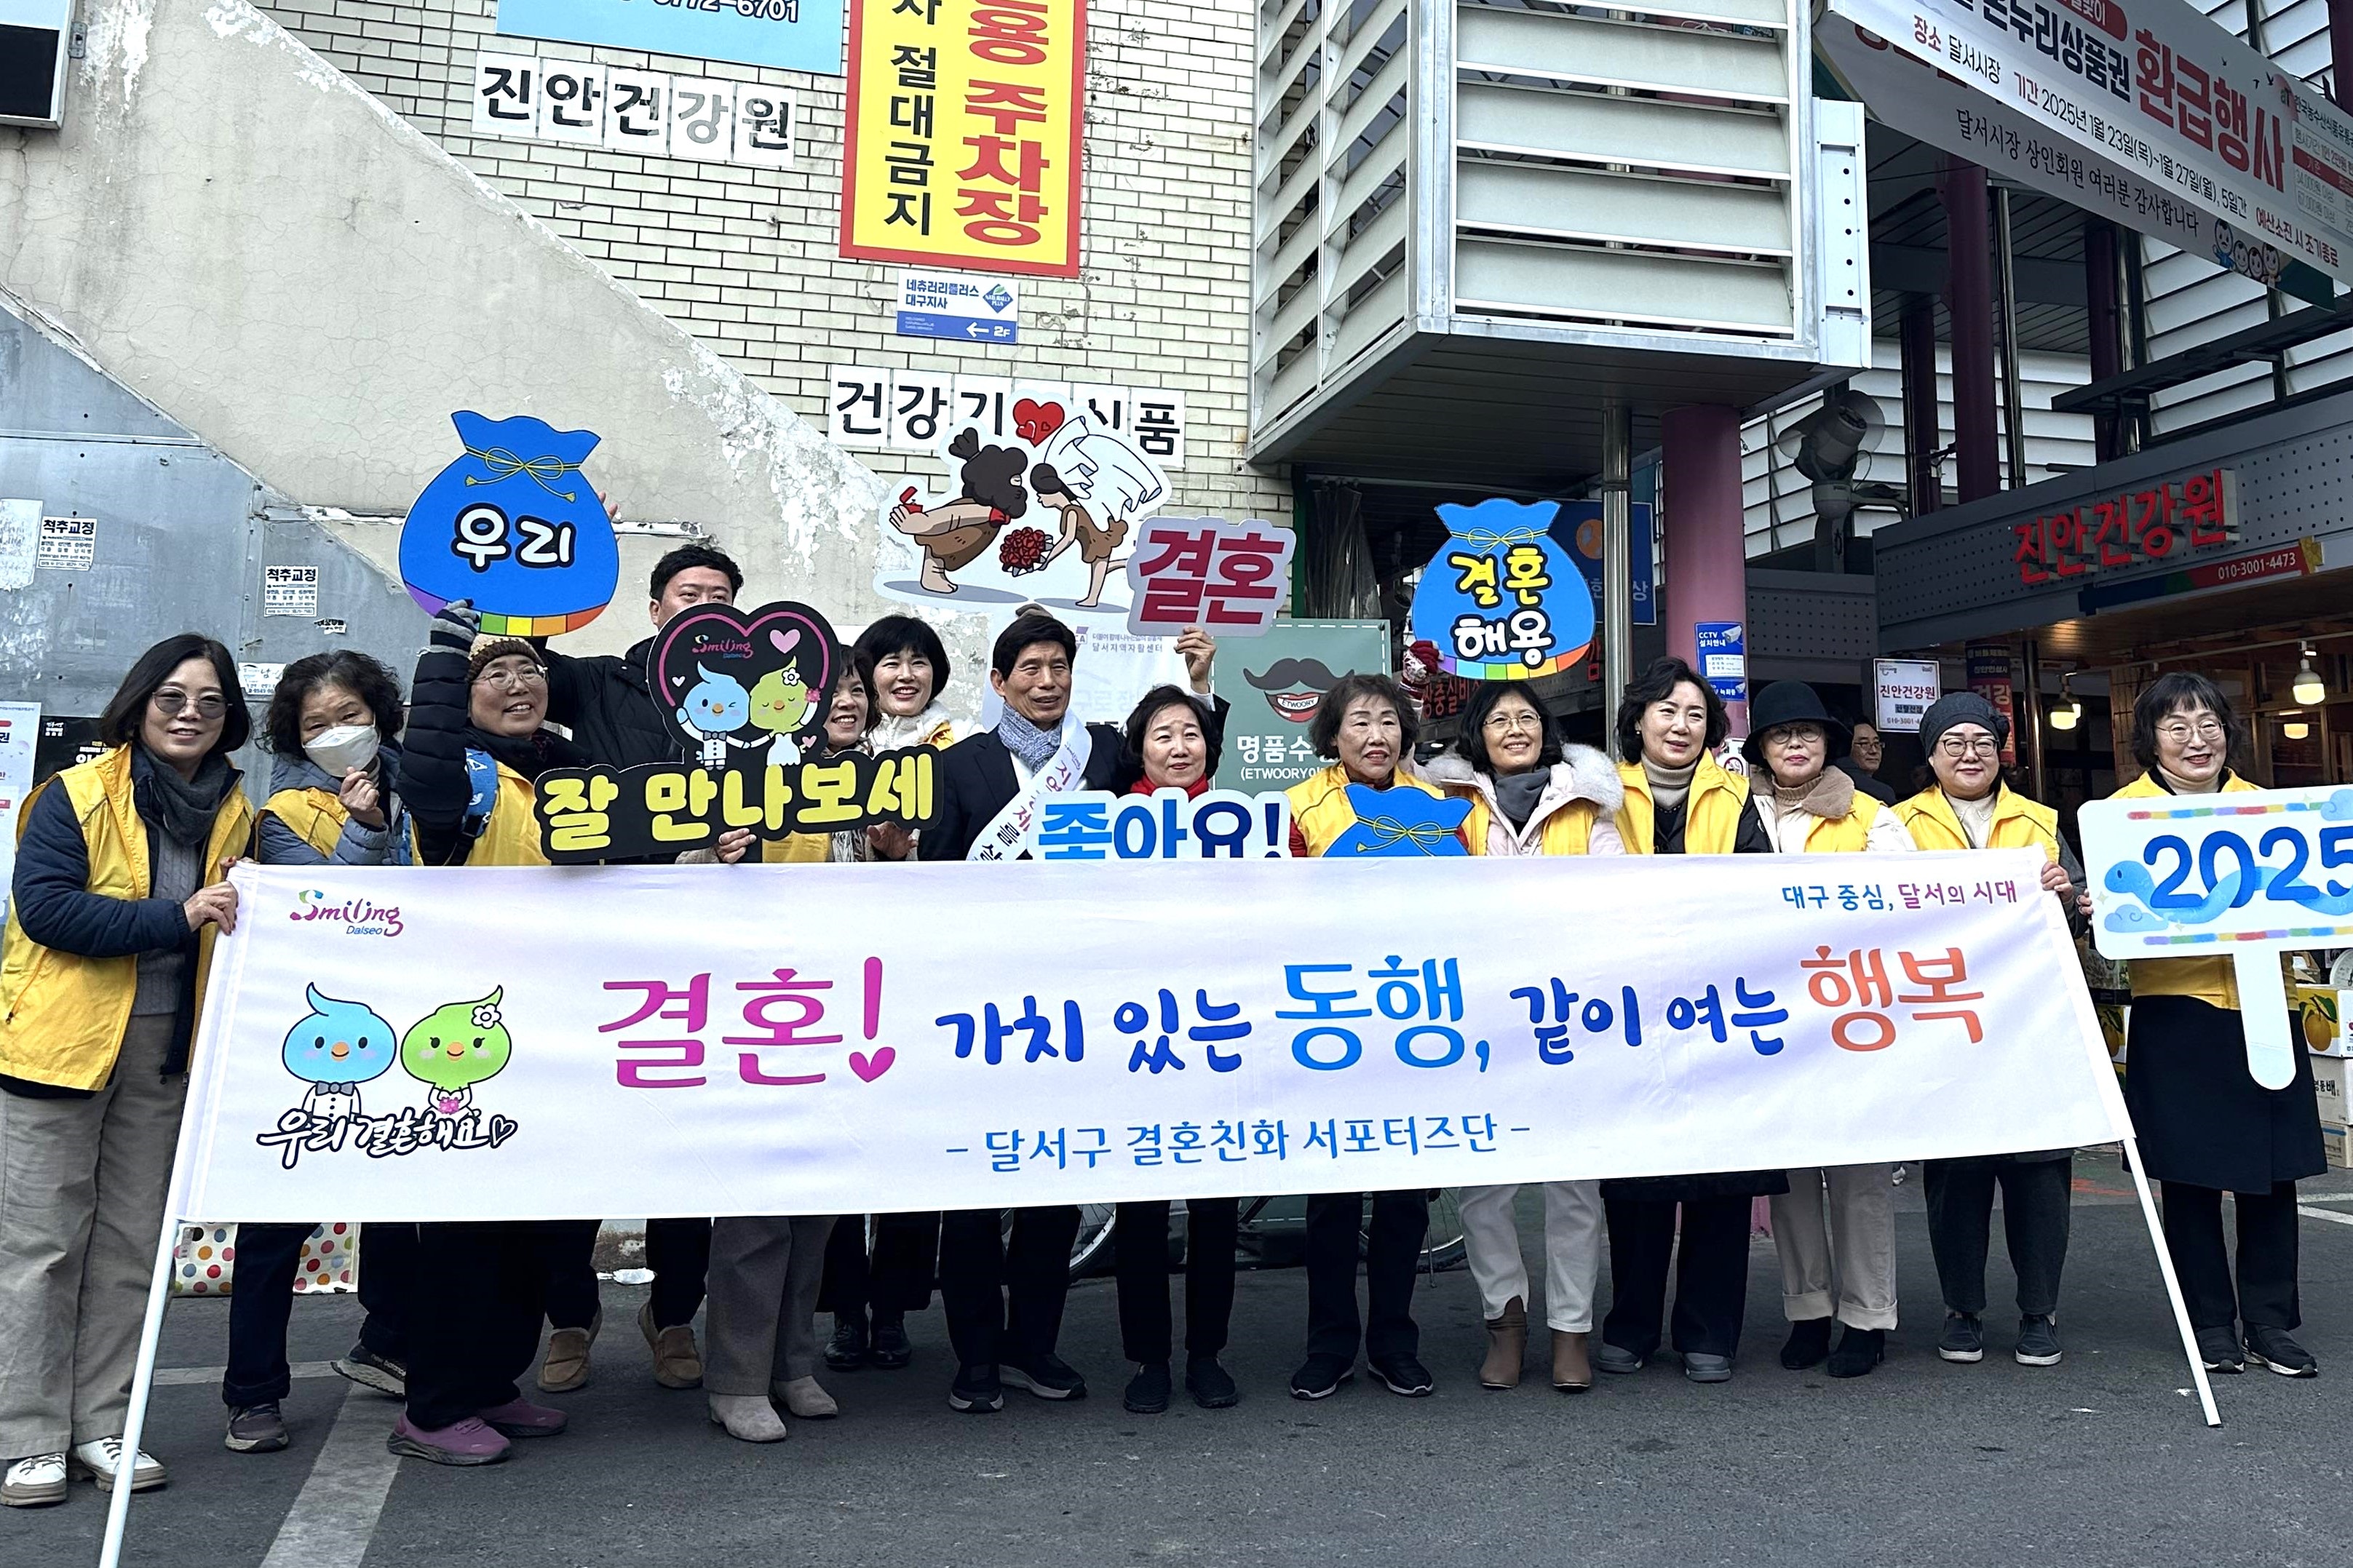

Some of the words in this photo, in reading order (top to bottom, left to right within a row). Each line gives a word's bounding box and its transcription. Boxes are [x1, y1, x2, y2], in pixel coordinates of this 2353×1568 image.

[968, 0, 1049, 65] 용
[481, 66, 790, 150] 진안건강원
[2135, 28, 2285, 194] 환급행사
[884, 44, 937, 236] 절대금지
[953, 79, 1050, 246] 주차장
[1914, 15, 1941, 52] 장소
[1949, 34, 2001, 84] 달서시장
[2014, 72, 2038, 106] 기간
[2041, 89, 2087, 132] 2025년
[2089, 114, 2105, 143] 1월
[2221, 187, 2247, 219] 5일간
[2256, 207, 2293, 244] 예산소진
[2295, 228, 2304, 248] 시
[2305, 233, 2338, 268] 조기종료
[1956, 108, 2021, 159] 달서시장
[2025, 139, 2084, 189] 상인회원
[2089, 168, 2130, 208] 여러분
[2134, 187, 2199, 238] 감사합니다
[905, 294, 948, 309] 대구지사
[993, 326, 1011, 338] 2F
[43, 519, 95, 535] 척추교정
[453, 505, 576, 571] 우리
[2014, 468, 2229, 584] 진안건강원
[266, 568, 317, 582] 척추교정
[1139, 529, 1285, 624] 결혼
[1451, 546, 1552, 606] 결혼
[2218, 552, 2296, 581] 010-3001-4473
[692, 634, 754, 658] Smiling
[1092, 643, 1162, 653] 달서지역자활센터
[1453, 609, 1552, 665] 해용
[1282, 699, 1315, 709] ETWOORY
[1880, 685, 1935, 700] 진안건강원
[1237, 735, 1336, 763] 명품수
[543, 775, 619, 851] 잘
[645, 752, 933, 842] 만나보세
[1782, 886, 1830, 910] 대구
[1838, 884, 1893, 911] 중심,
[1897, 883, 1965, 910] 달서의
[1973, 880, 2017, 904] 시대
[2143, 826, 2353, 908] 2025
[290, 889, 404, 937] Smiling
[346, 925, 383, 935] Dalseo
[598, 956, 896, 1089] 결혼!
[935, 994, 1084, 1065] 가치
[1114, 987, 1252, 1075] 있는
[1275, 955, 1491, 1072] 동행,
[1509, 977, 1642, 1065] 같이
[1667, 977, 1789, 1056] 여는
[1800, 945, 1985, 1052] 행복
[257, 1108, 347, 1170] 우리
[354, 1106, 490, 1159] 결혼해요
[985, 1128, 1111, 1173] 달서구
[1126, 1118, 1289, 1166] 결혼친화
[1303, 1113, 1499, 1158] 서포터즈단
